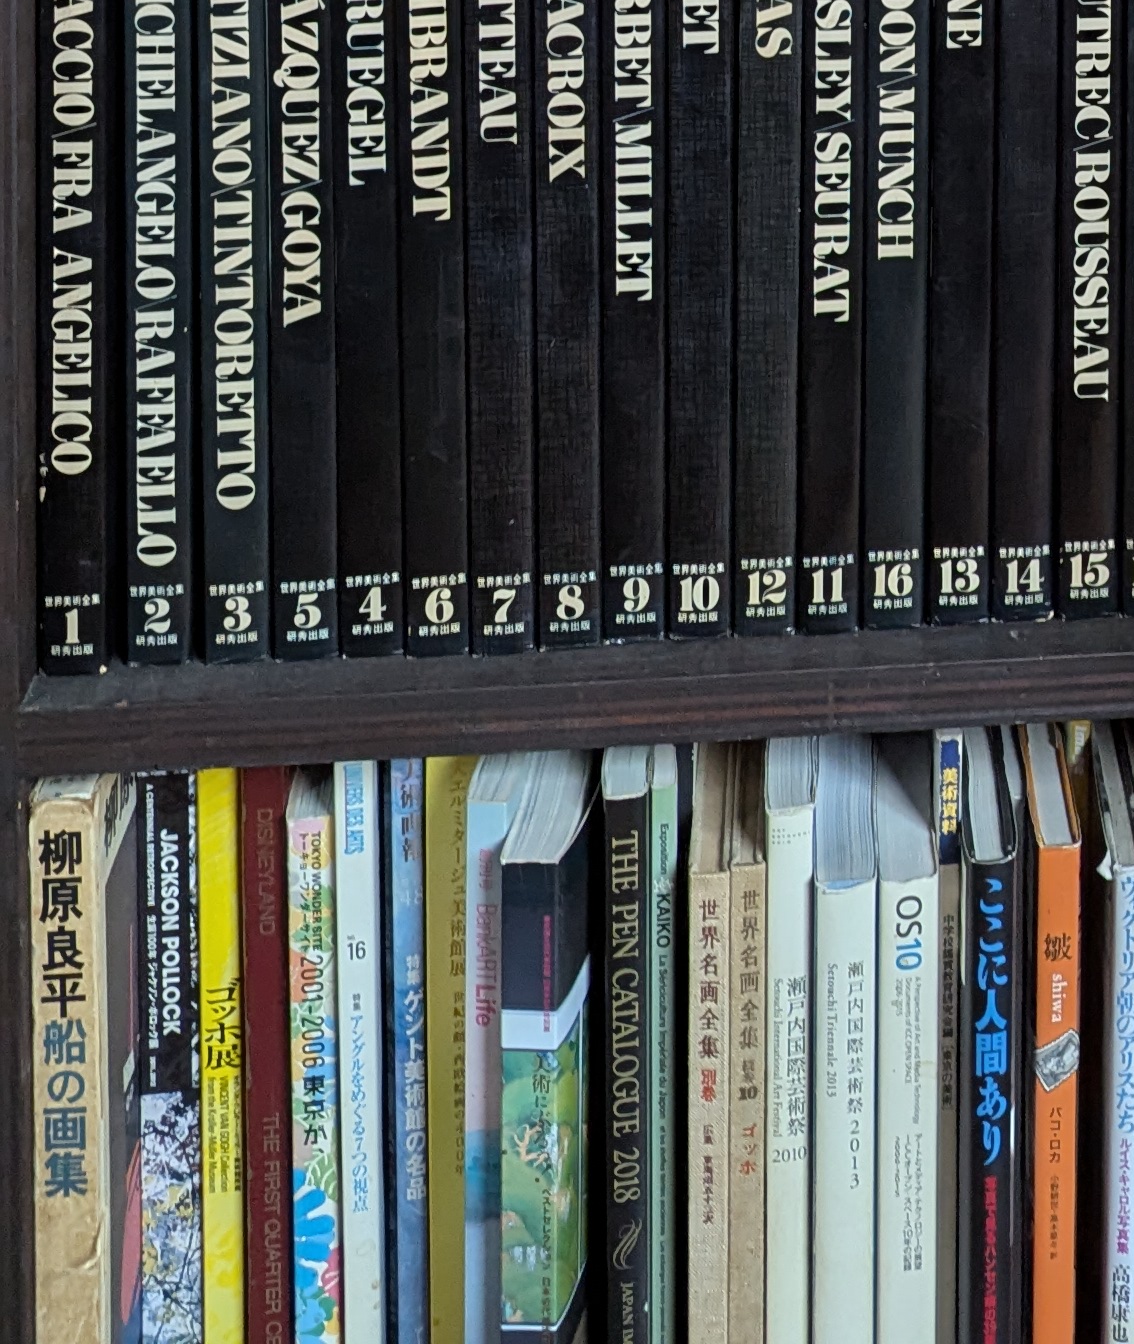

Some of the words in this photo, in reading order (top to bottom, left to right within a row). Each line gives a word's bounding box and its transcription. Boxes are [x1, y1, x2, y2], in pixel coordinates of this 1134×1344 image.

[51, 248, 93, 476] ANGELICO
[679, 576, 719, 611] 10
[1069, 552, 1110, 588] 15
[64, 608, 81, 644] 1
[143, 597, 171, 633] 2
[222, 596, 252, 632] 3
[941, 768, 958, 835] 美術資料
[160, 828, 180, 931] JACKSON
[612, 829, 639, 894] THE
[38, 829, 87, 1018] 柳原良平
[612, 901, 639, 958] PEN
[657, 893, 671, 948] KAIKO
[895, 895, 923, 971] OS10
[1044, 932, 1073, 962] 皺
[161, 936, 182, 1036] POLLOCK
[698, 898, 720, 1059] 世界名画全集
[1052, 973, 1068, 1023] shiwa
[205, 977, 242, 1070] ゴッホ展
[300, 955, 325, 1070] 2001-2006
[974, 878, 1008, 1167] ここに人間あり
[611, 967, 640, 1138] CATALOGUE
[43, 1018, 89, 1198] 船の画集
[612, 1147, 641, 1204] 2018
[772, 1145, 808, 1163] 2010
[1116, 1137, 1133, 1255] ルイス・キャロル写真集
